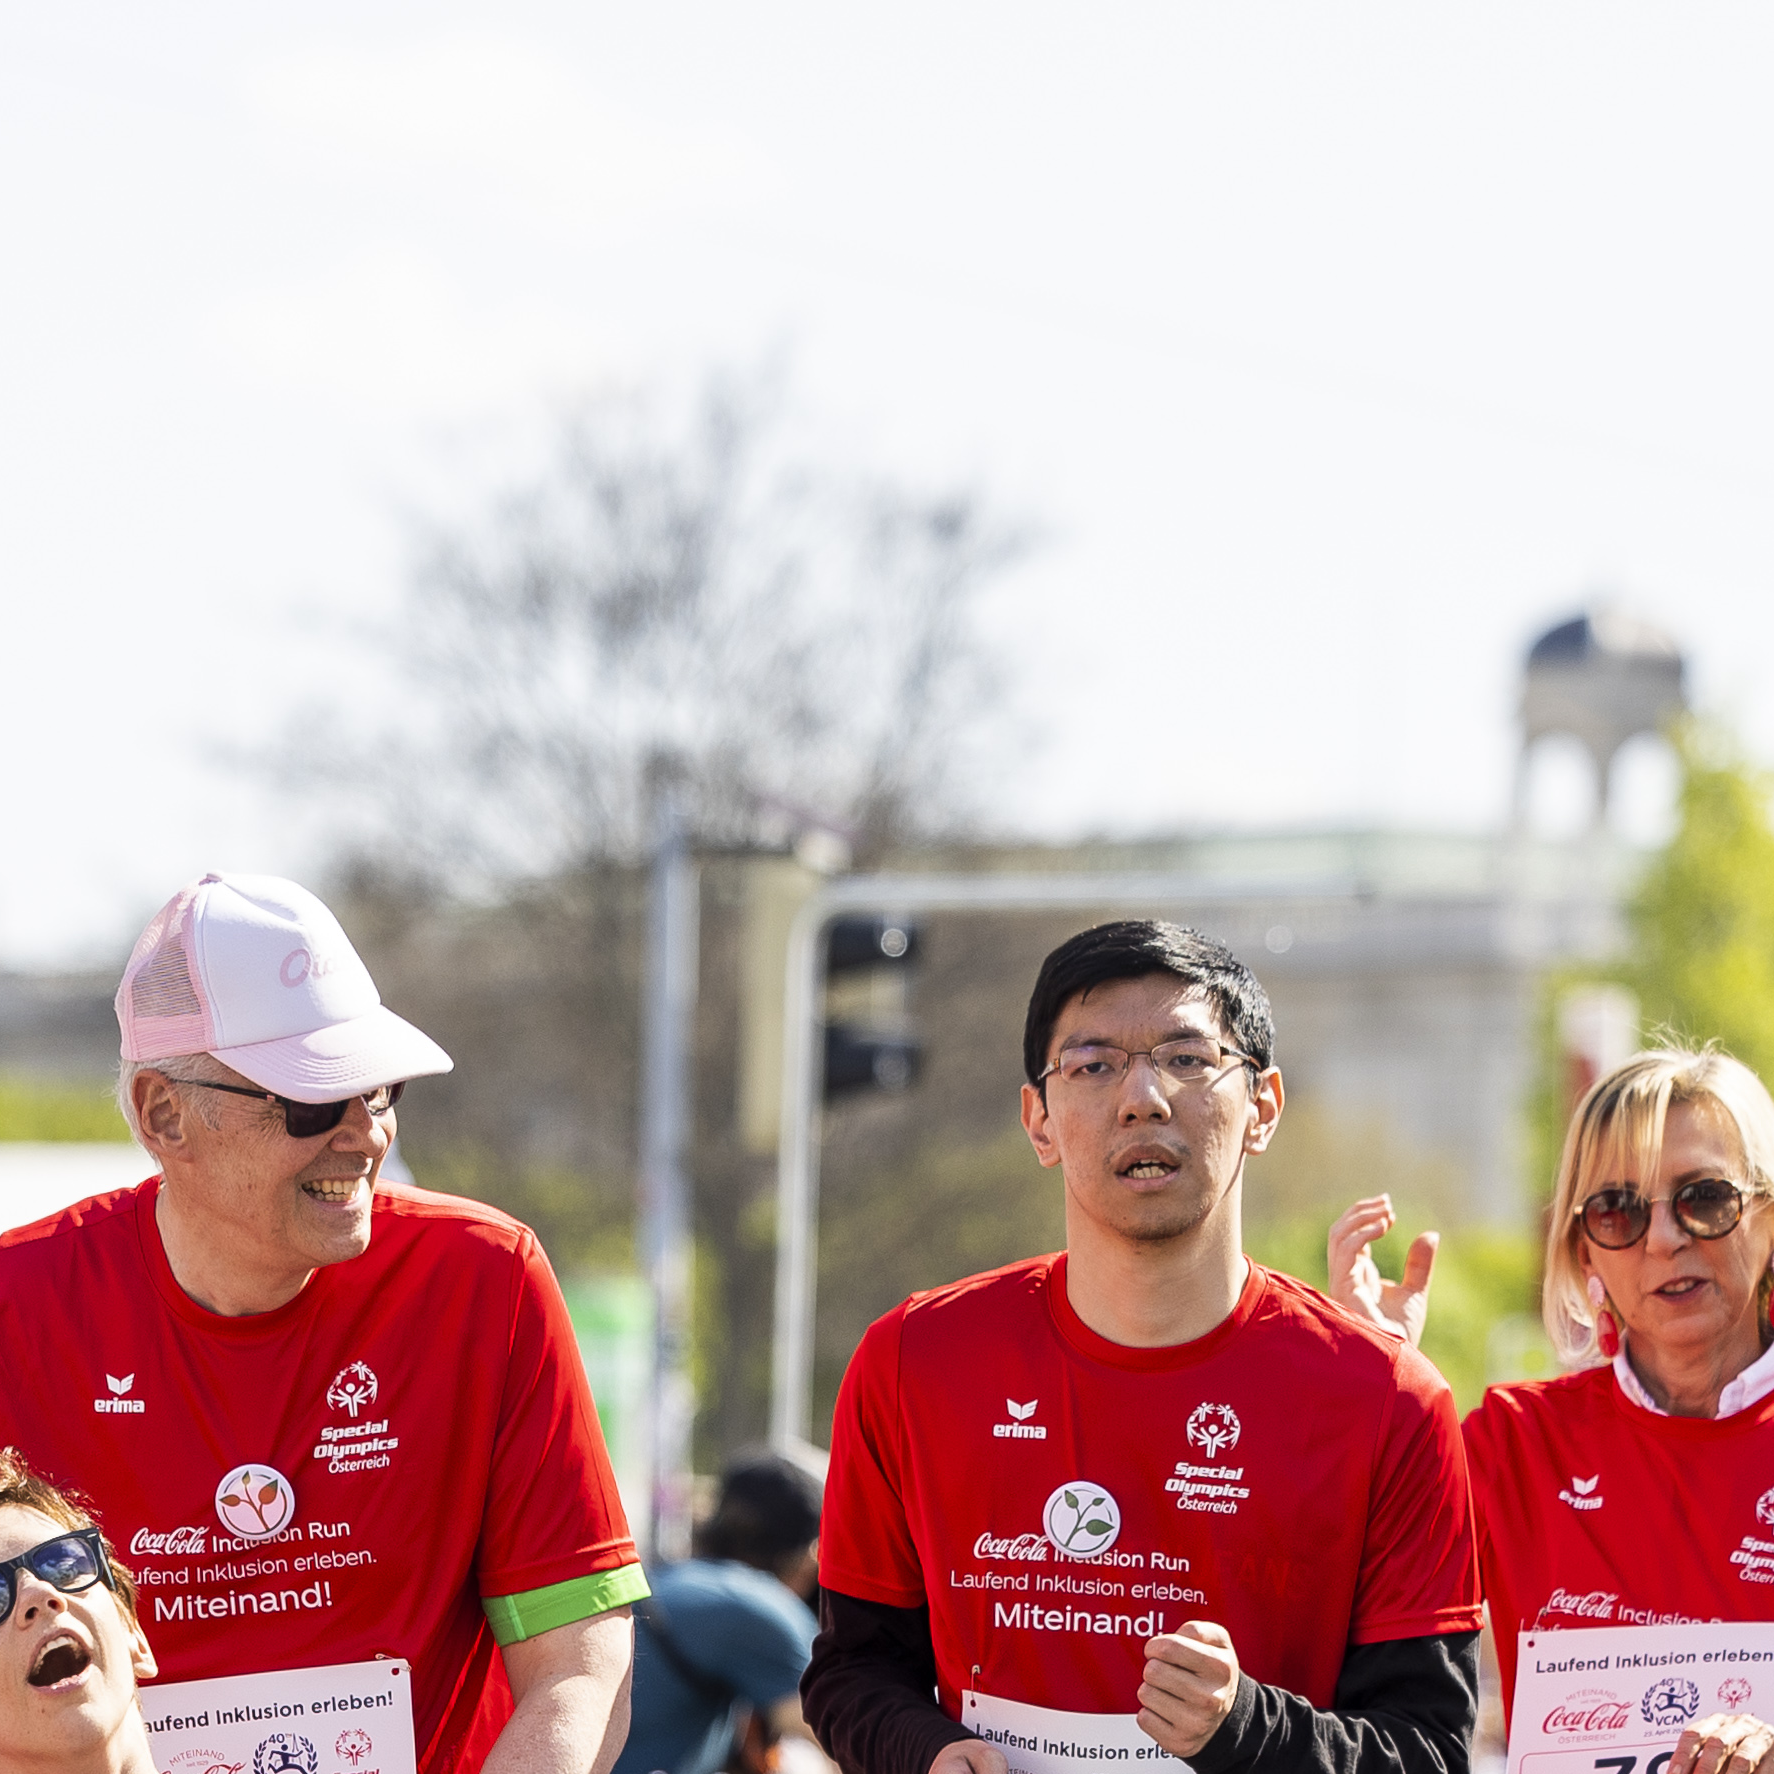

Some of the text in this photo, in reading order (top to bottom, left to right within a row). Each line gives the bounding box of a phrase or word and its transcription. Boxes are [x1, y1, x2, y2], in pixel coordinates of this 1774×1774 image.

[94, 1397, 145, 1413] erima
[321, 1419, 388, 1441] Special
[993, 1422, 1047, 1439] erima
[313, 1437, 398, 1460] Olympics
[328, 1453, 390, 1474] Österreich
[1174, 1462, 1244, 1481] Special
[1165, 1478, 1250, 1499] Olympics
[1176, 1494, 1237, 1514] Österreich
[130, 1526, 210, 1555] Coca-Cola
[308, 1521, 350, 1539] Run
[973, 1532, 1049, 1561] Coca-Cola
[1151, 1552, 1190, 1572] Run
[131, 1548, 377, 1586] ufend Inklusion erleben.
[950, 1570, 1208, 1605] Laufend Inklusion erleben.
[154, 1581, 333, 1622] Miteinand!
[1547, 1588, 1618, 1619] Coca-Cola
[994, 1602, 1164, 1638] Miteinand!
[1536, 1656, 1609, 1674] Laufend
[1615, 1651, 1696, 1668] Inklusion
[1565, 1688, 1617, 1702] MITEINAND
[216, 1703, 304, 1725] Inklusion
[311, 1691, 394, 1714] erleben!
[1542, 1701, 1636, 1735] Coca-Cola
[1655, 1714, 1685, 1726] VCM
[976, 1723, 1037, 1752] Laufend
[1043, 1739, 1127, 1760] Inklusion
[1558, 1732, 1616, 1745] ÖSTERREICH
[1655, 1729, 1671, 1738] April
[169, 1748, 225, 1767] MITEINAND
